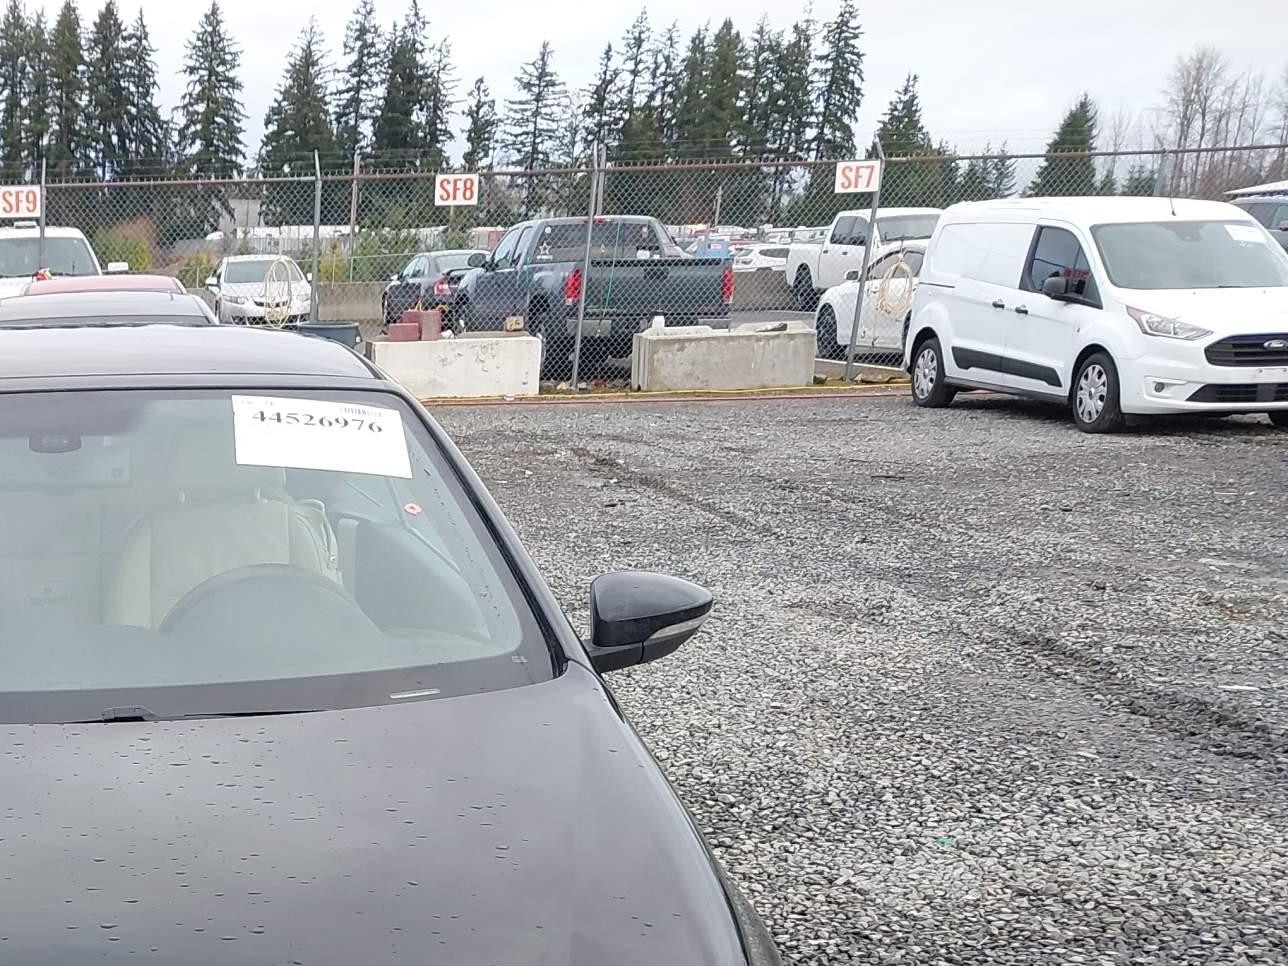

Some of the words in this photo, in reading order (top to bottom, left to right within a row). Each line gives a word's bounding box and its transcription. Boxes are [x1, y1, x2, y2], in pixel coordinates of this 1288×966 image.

[841, 165, 875, 189] SF7
[440, 178, 474, 201] SF8
[2, 190, 37, 213] SF9
[252, 410, 383, 433] 44526976
